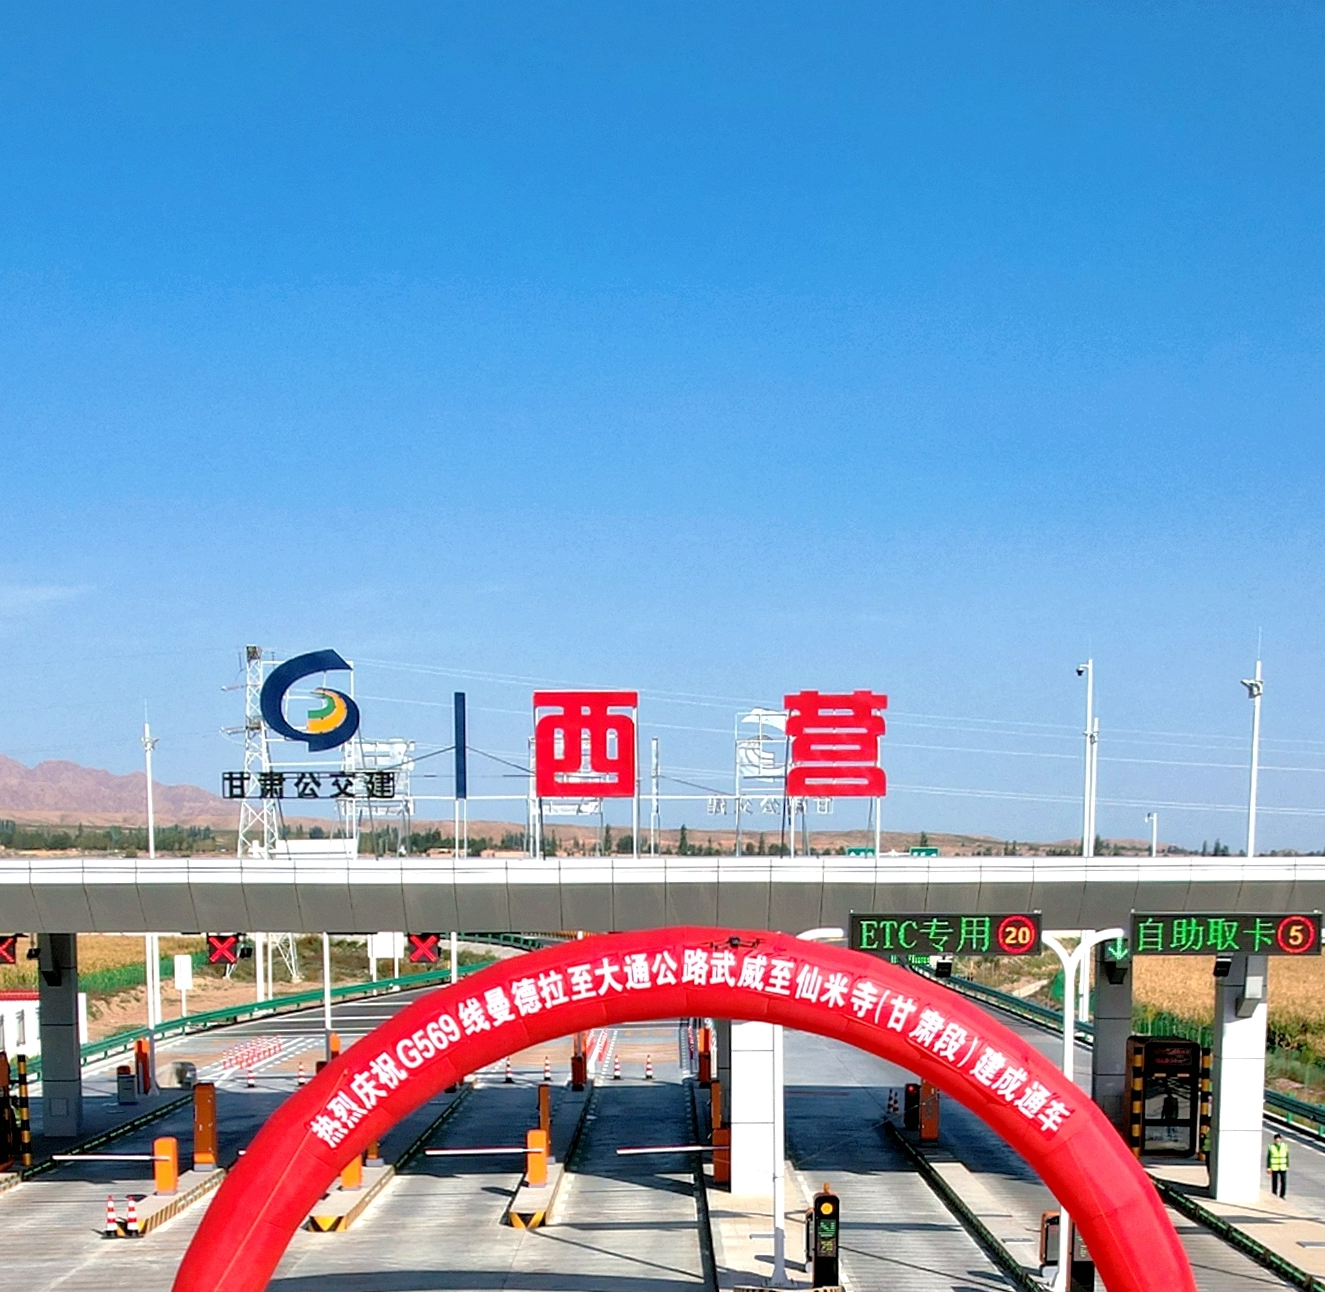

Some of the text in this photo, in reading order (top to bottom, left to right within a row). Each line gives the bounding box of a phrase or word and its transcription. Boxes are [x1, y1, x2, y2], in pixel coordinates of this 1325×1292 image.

[534, 691, 888, 797] 西营
[224, 772, 394, 799] 甘肃公交建
[859, 917, 1031, 952] ETC专用 20
[1138, 917, 1305, 952] 自助取卡 5
